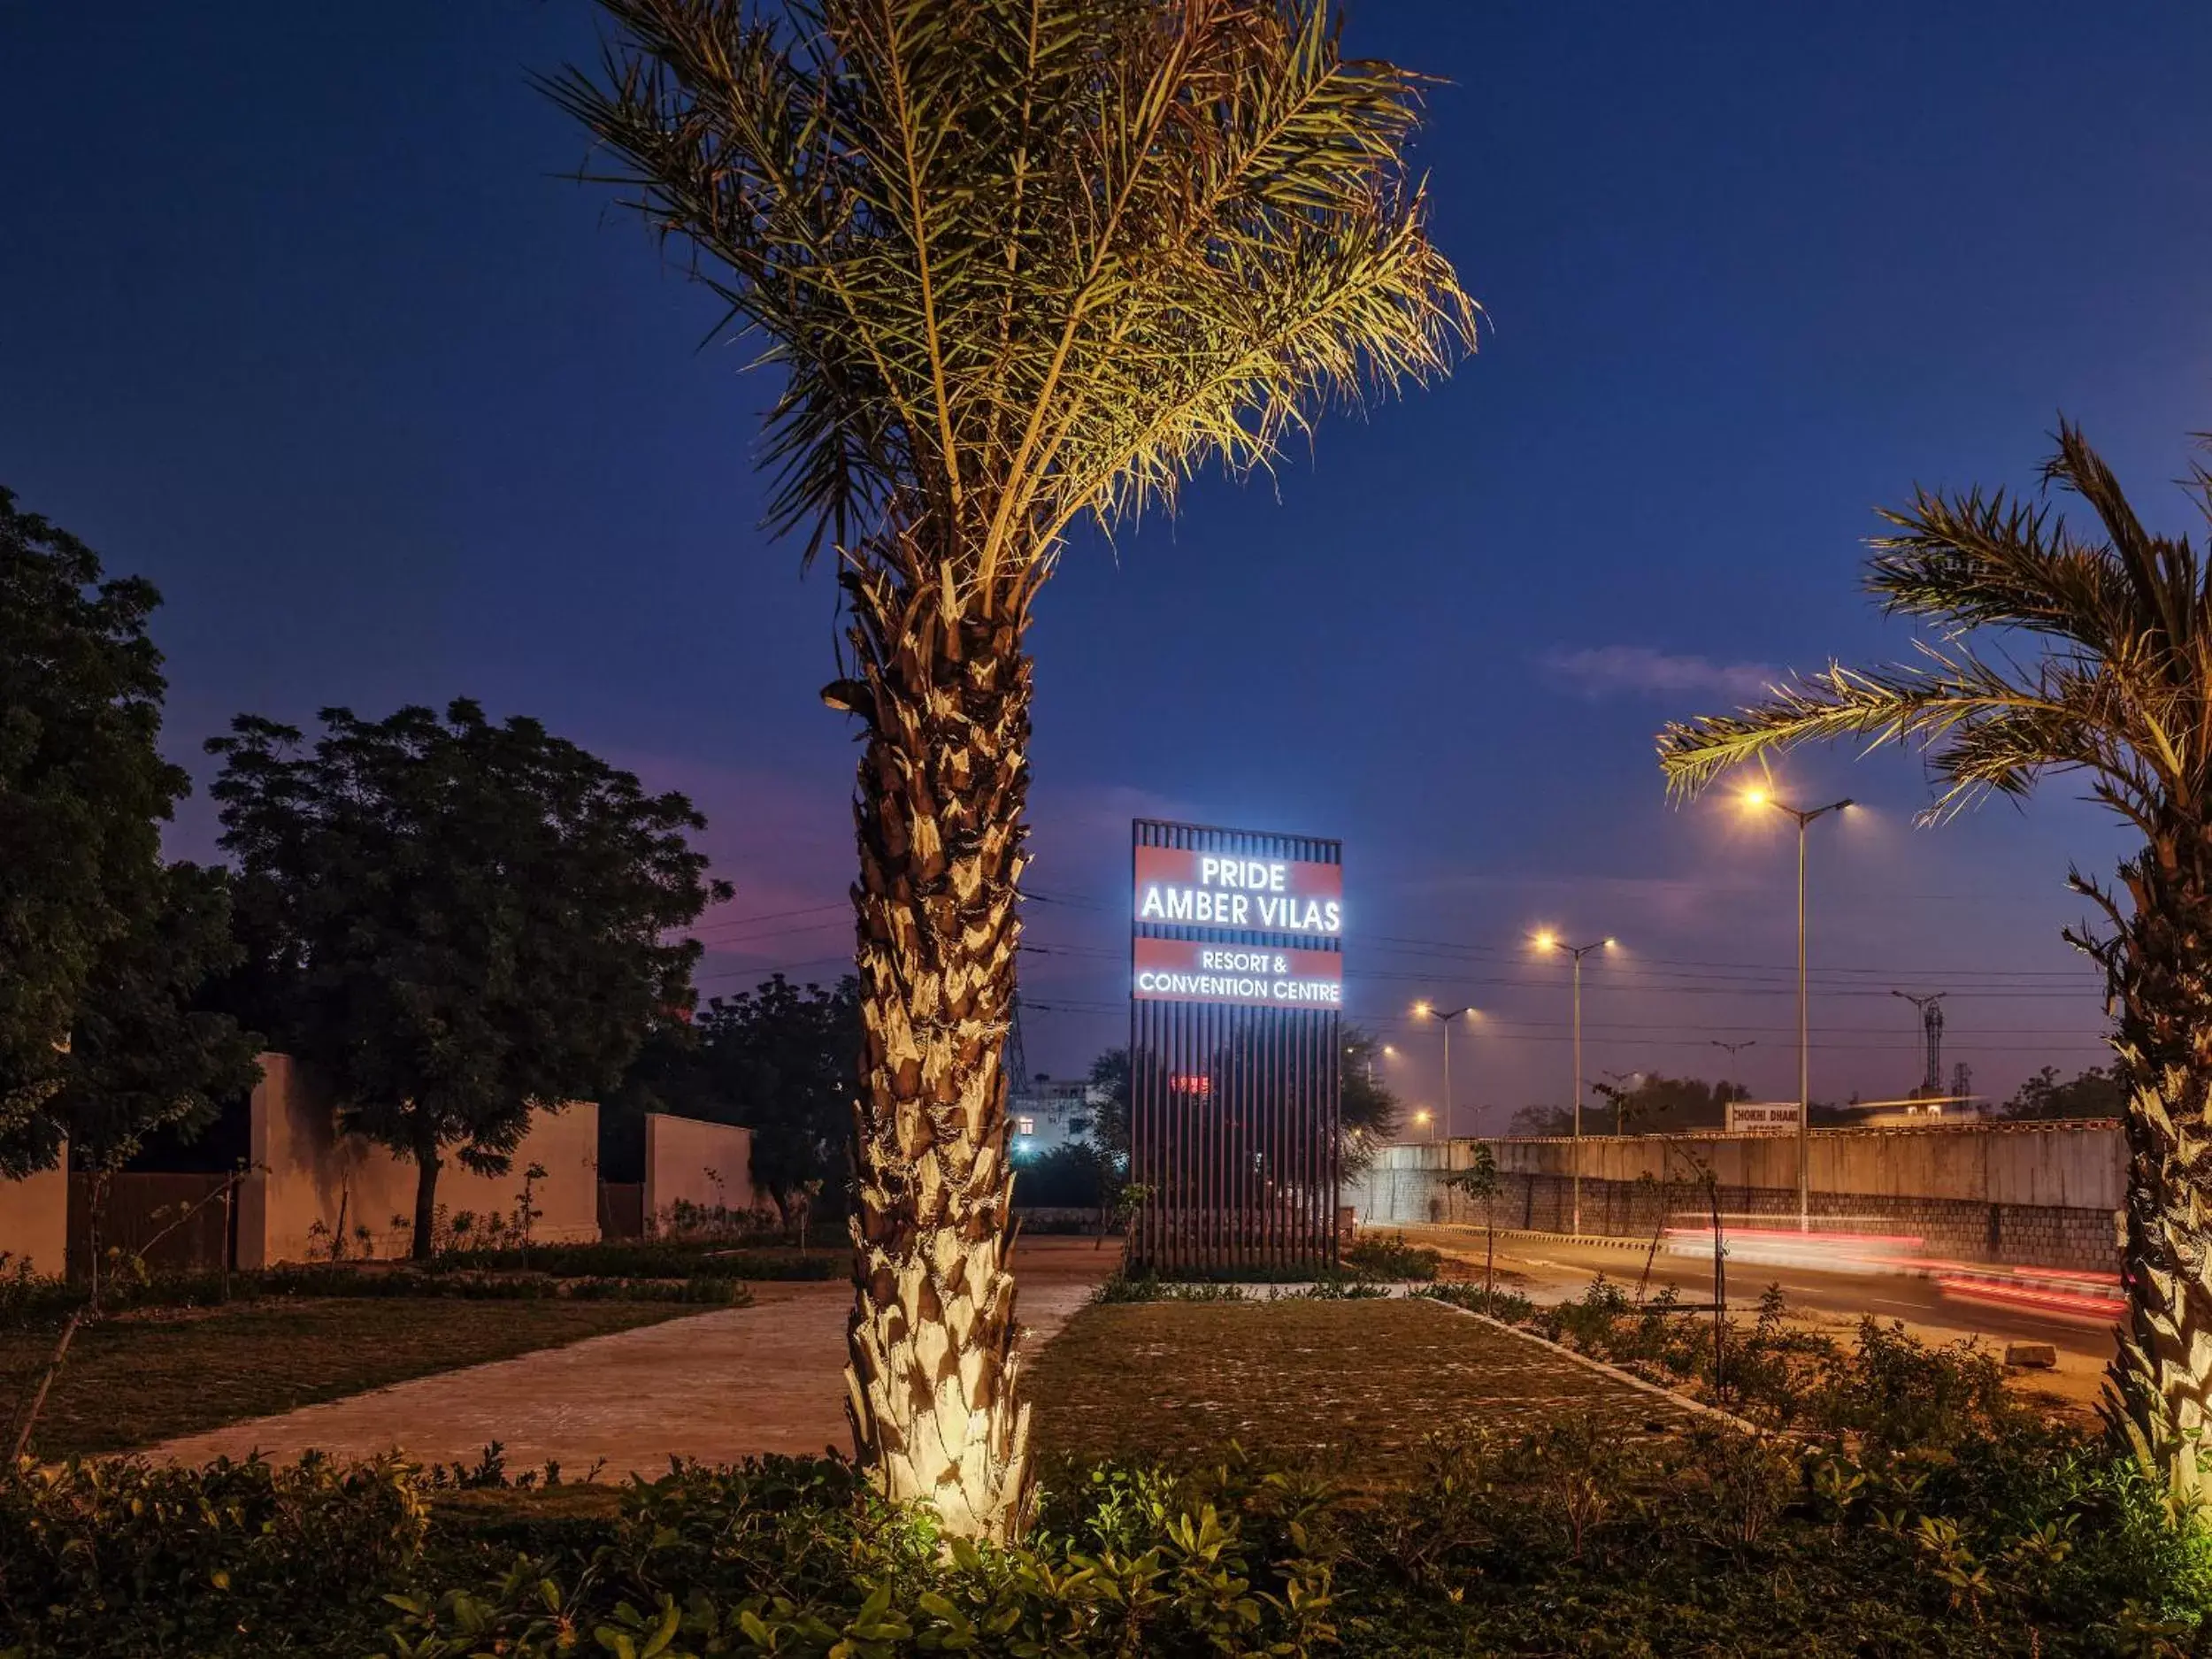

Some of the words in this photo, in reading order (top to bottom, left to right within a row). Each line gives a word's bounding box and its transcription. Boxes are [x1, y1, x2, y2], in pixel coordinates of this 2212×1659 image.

[1202, 857, 1286, 892] PRIDE
[1141, 887, 1248, 925] AMBER
[1256, 897, 1341, 932] VILAS
[1202, 951, 1269, 973] RESORT
[1274, 956, 1287, 974] &
[1139, 972, 1268, 998] CONVENTION
[1274, 981, 1341, 1003] CENTRE
